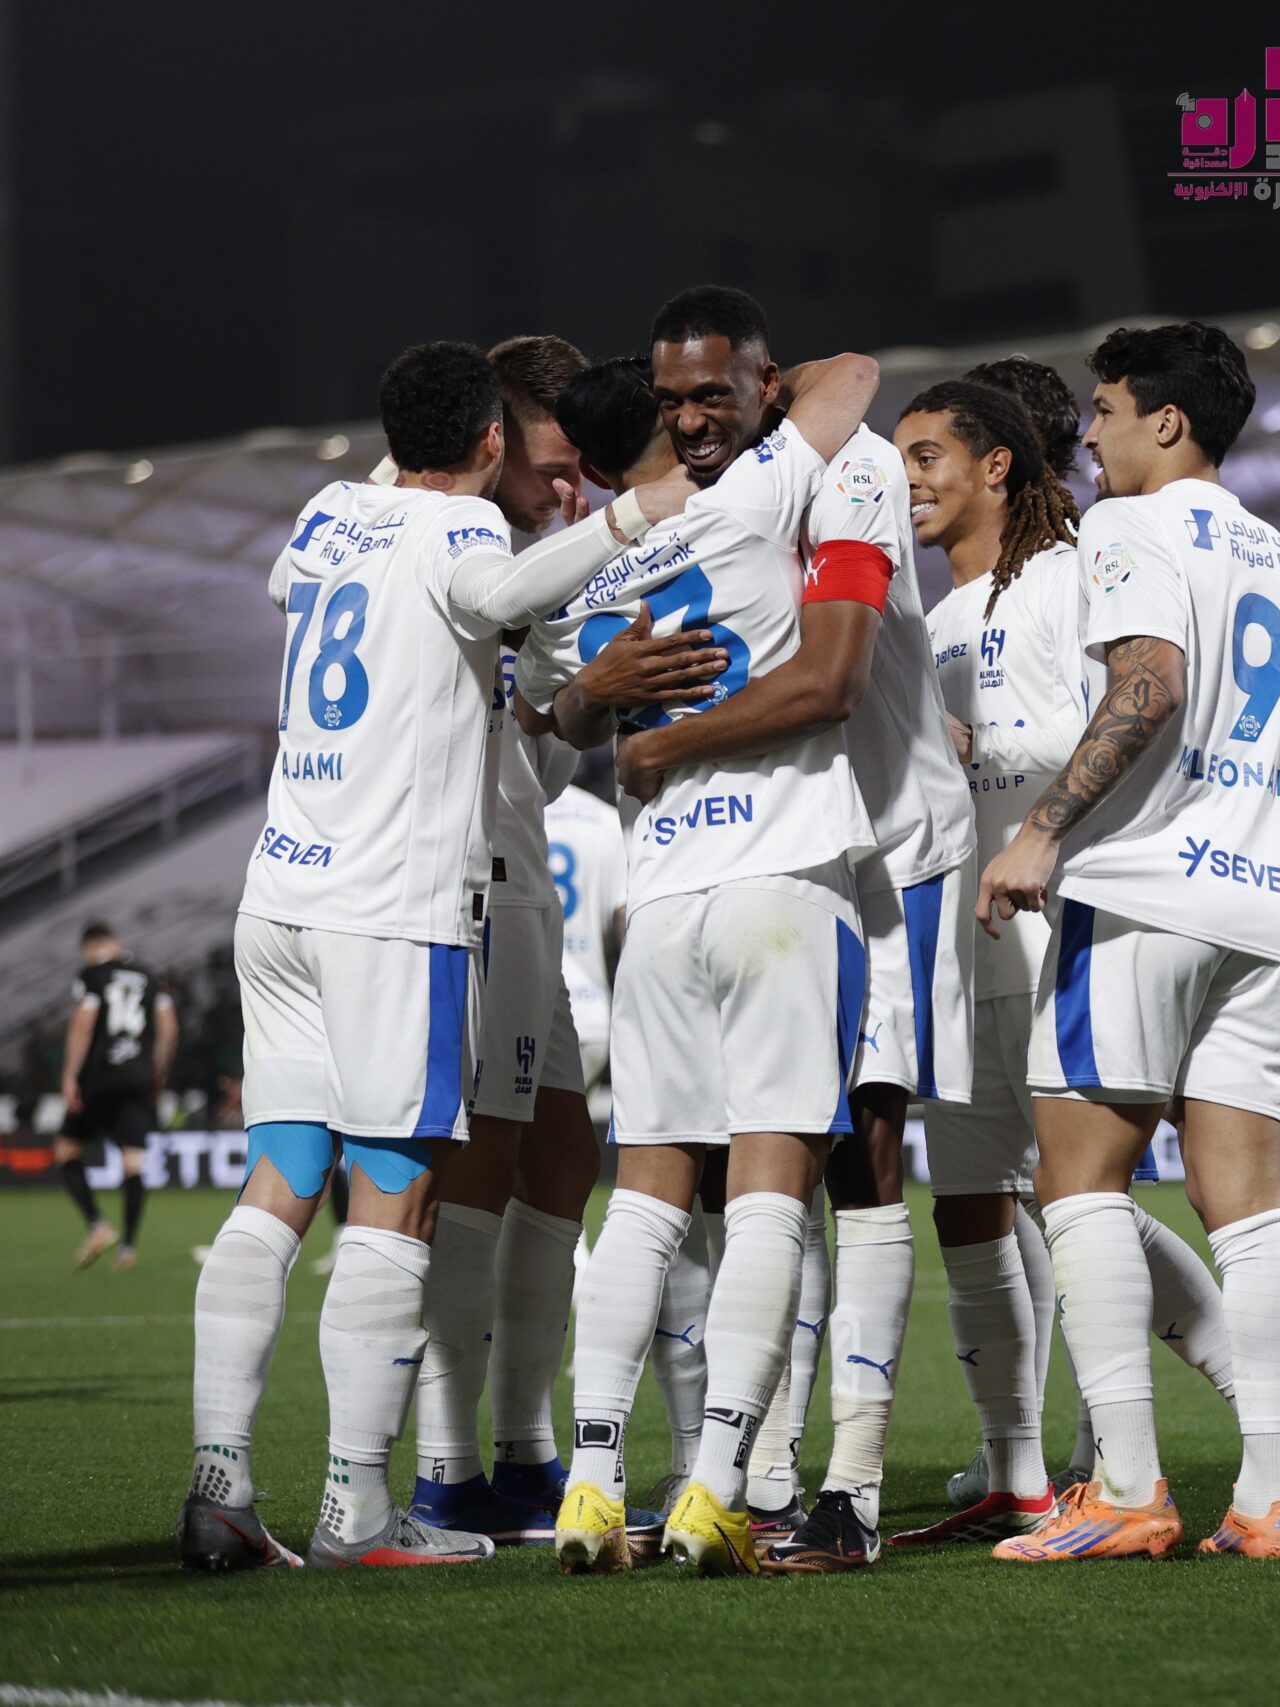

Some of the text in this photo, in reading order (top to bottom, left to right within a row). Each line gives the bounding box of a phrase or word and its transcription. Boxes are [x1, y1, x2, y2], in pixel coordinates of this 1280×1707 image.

[852, 474, 873, 485] RSL
[1229, 539, 1275, 568] Riyad
[278, 582, 370, 731] 78
[282, 750, 344, 781] AJAMI
[968, 775, 1025, 794] ROUP
[654, 794, 753, 846] SVEN
[260, 826, 341, 868] SEVEN
